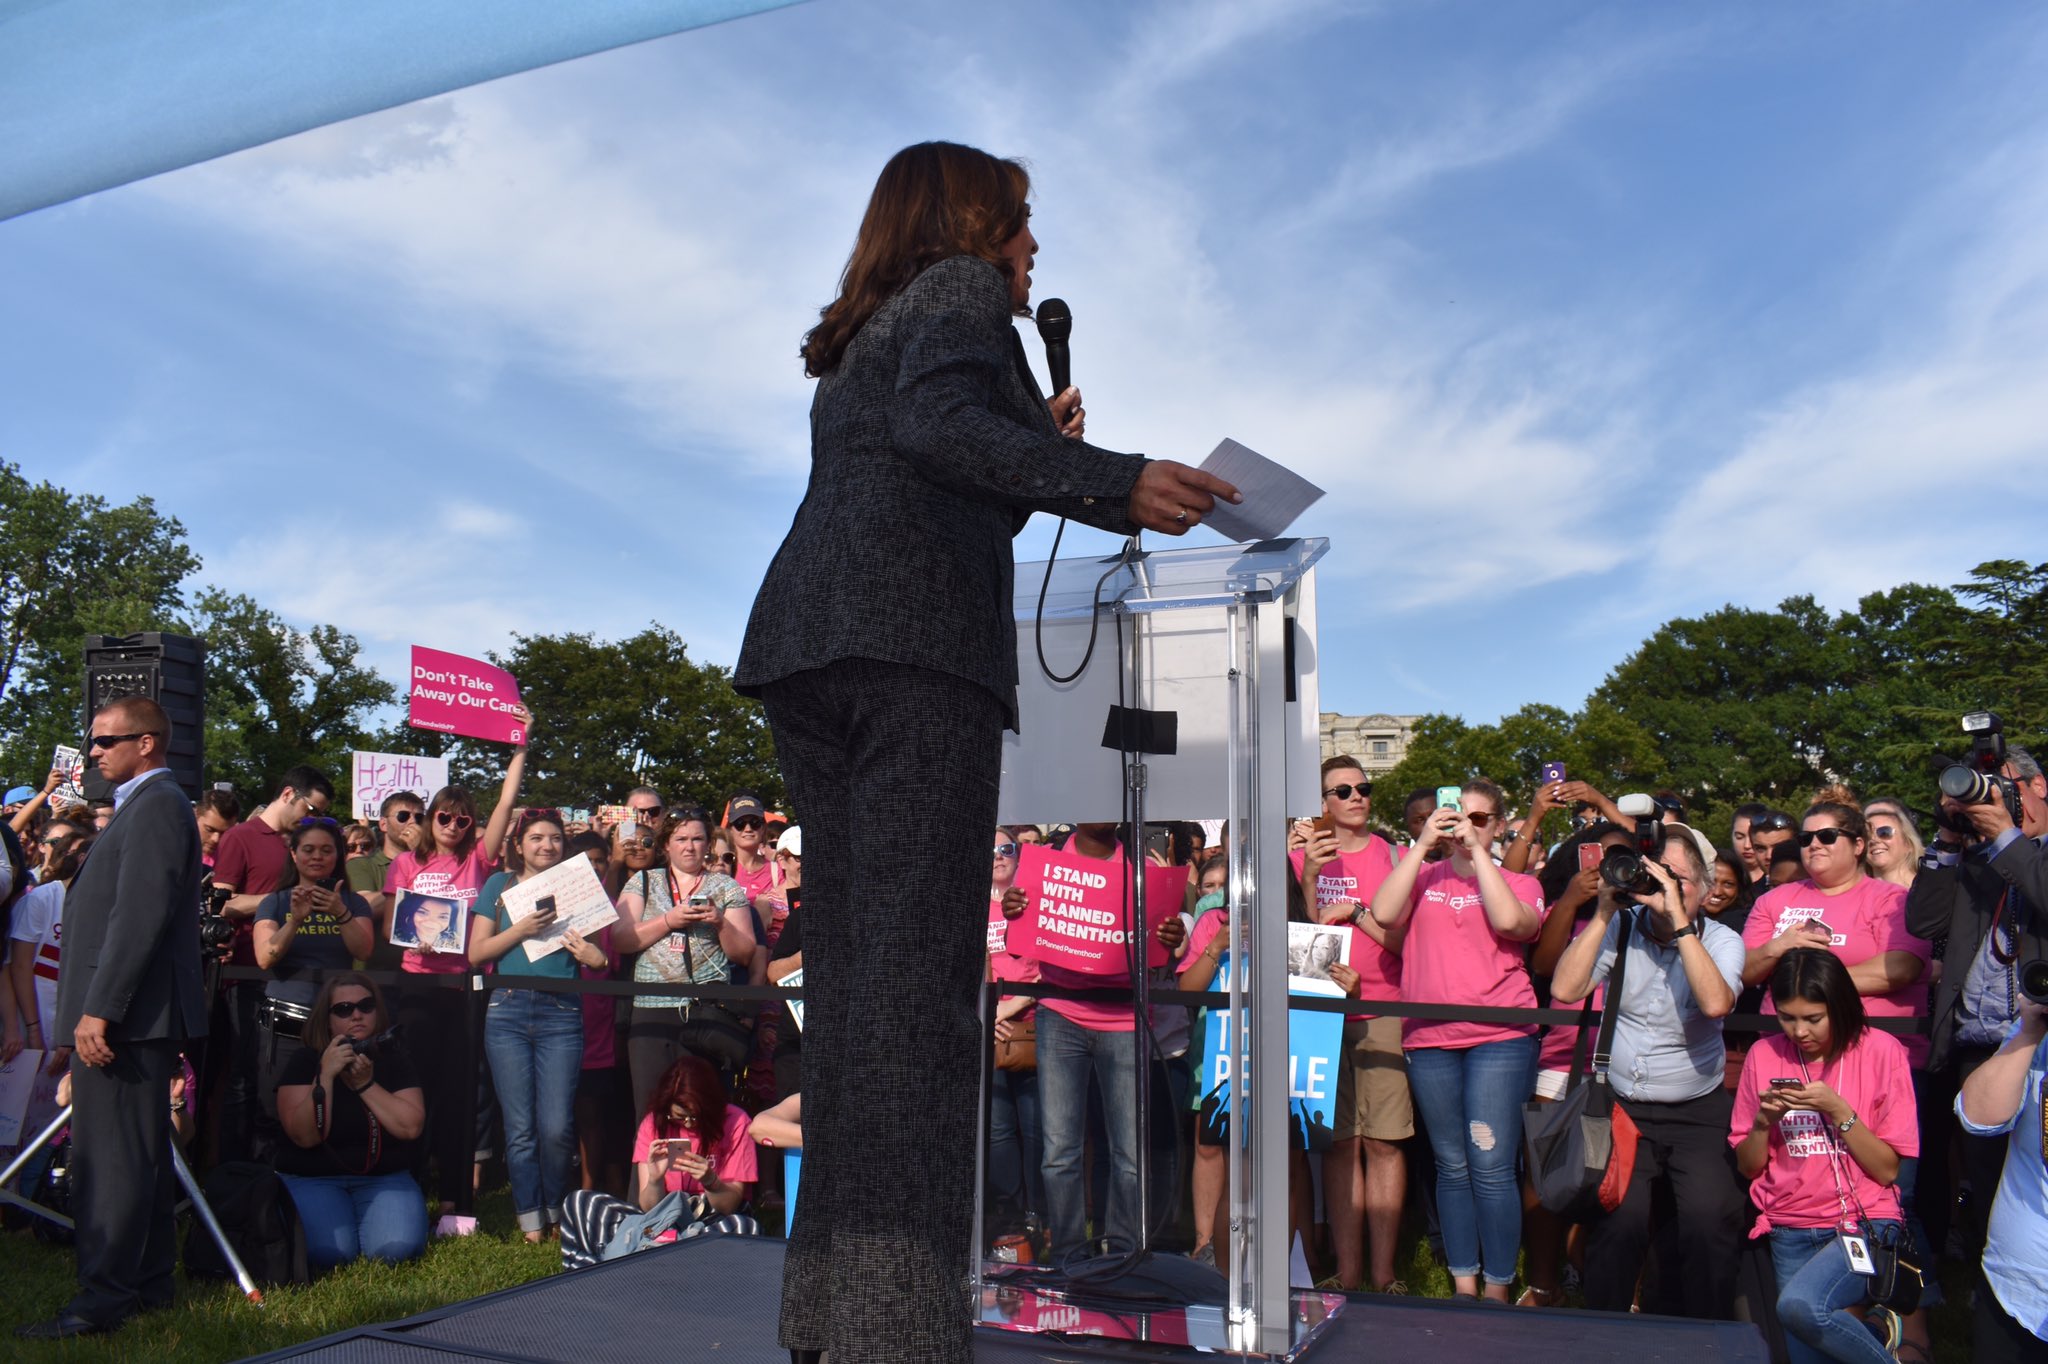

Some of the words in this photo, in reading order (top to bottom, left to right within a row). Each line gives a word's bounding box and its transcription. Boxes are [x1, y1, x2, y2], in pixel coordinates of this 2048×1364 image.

[414, 665, 457, 685] Don't
[459, 674, 494, 691] Take
[413, 684, 456, 706] Away
[458, 692, 487, 708] Our
[358, 753, 423, 787] Health
[1043, 863, 1051, 878] I
[1052, 865, 1107, 889] STAND
[1322, 878, 1355, 887] STAND
[1042, 881, 1084, 903] WITH
[1317, 887, 1343, 896] WITH
[1040, 897, 1116, 926] PLANNED
[1788, 909, 1821, 917] STAND
[295, 925, 341, 935] MERIC
[1042, 939, 1065, 952] Planned
[1064, 945, 1104, 960] Parenthood
[1214, 1054, 1329, 1099] PELE
